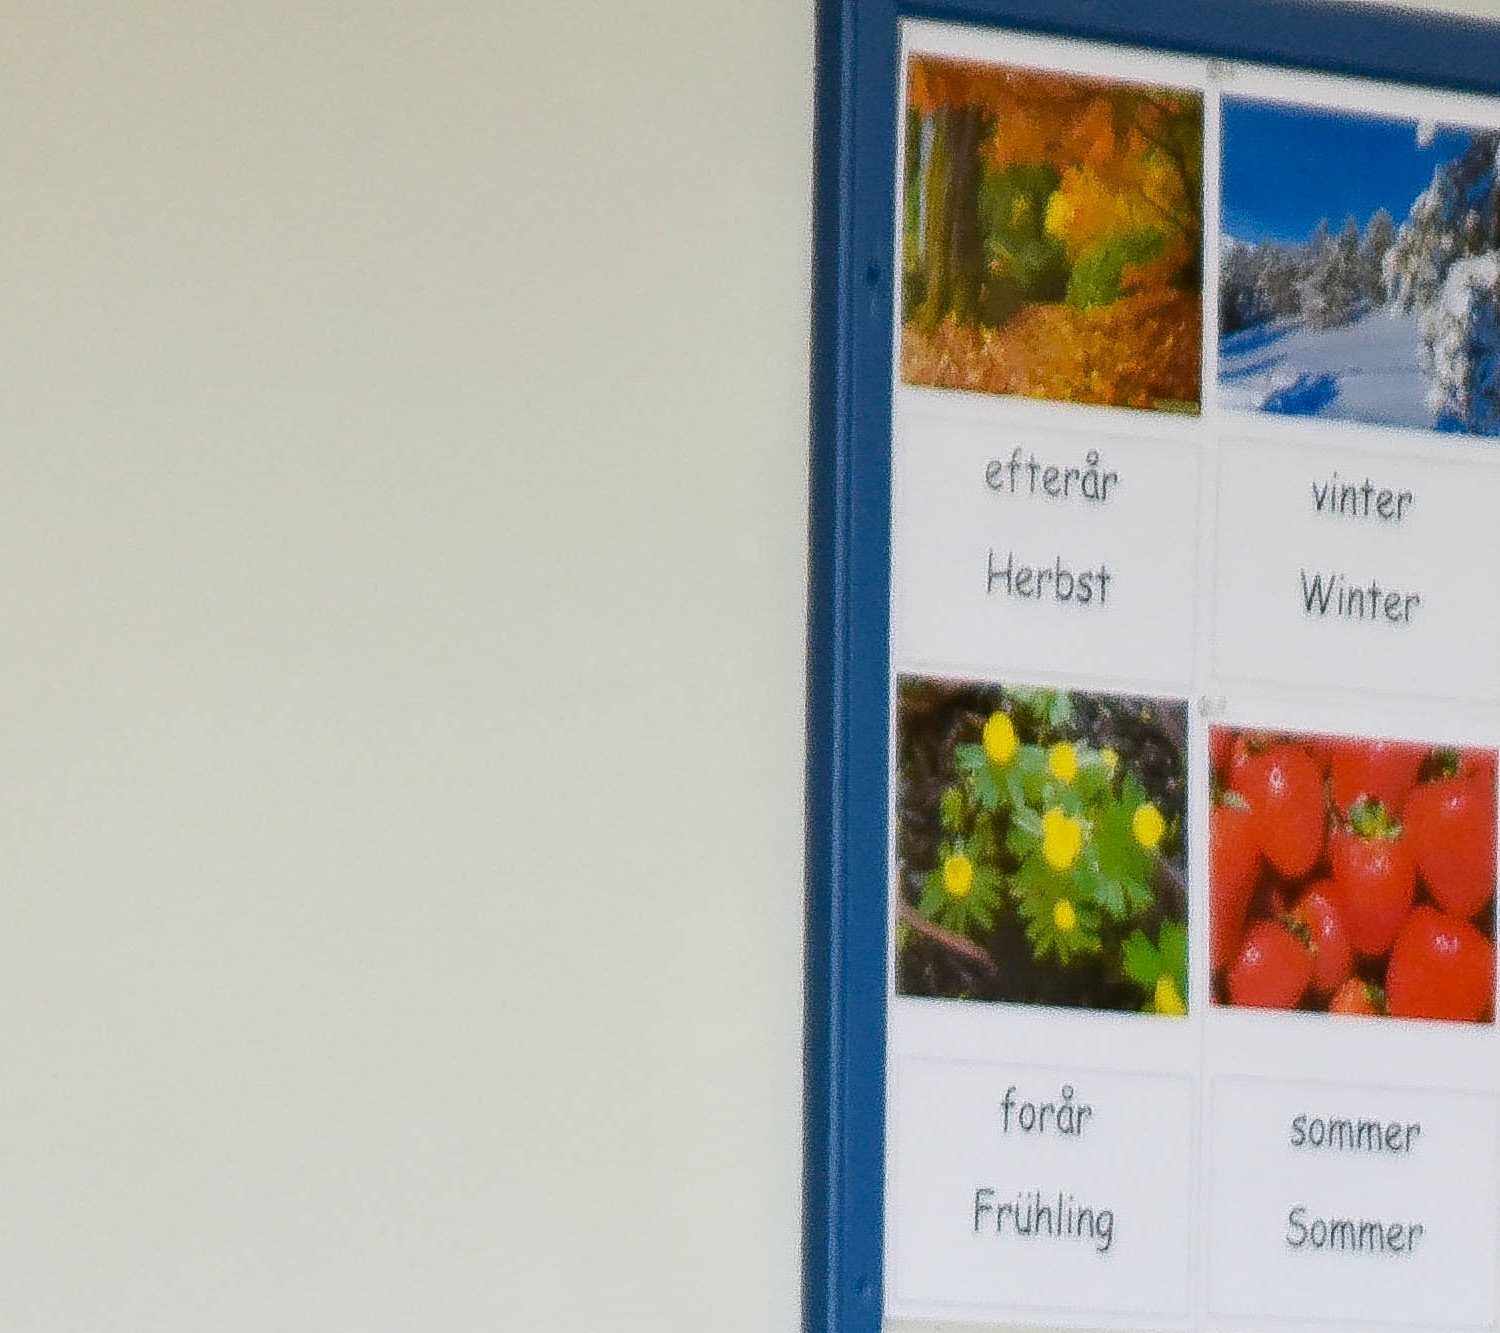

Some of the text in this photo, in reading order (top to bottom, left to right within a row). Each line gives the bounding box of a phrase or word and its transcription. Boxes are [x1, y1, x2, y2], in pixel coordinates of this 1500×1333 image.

[984, 447, 1119, 503] efterår
[1312, 472, 1414, 522] vinter
[986, 551, 1112, 605] Herbst
[1300, 571, 1421, 623] Winter
[1000, 1085, 1093, 1137] forår
[1290, 1114, 1422, 1154] sommer
[973, 1187, 1115, 1255] Frühling
[1286, 1206, 1424, 1256] Sommer
